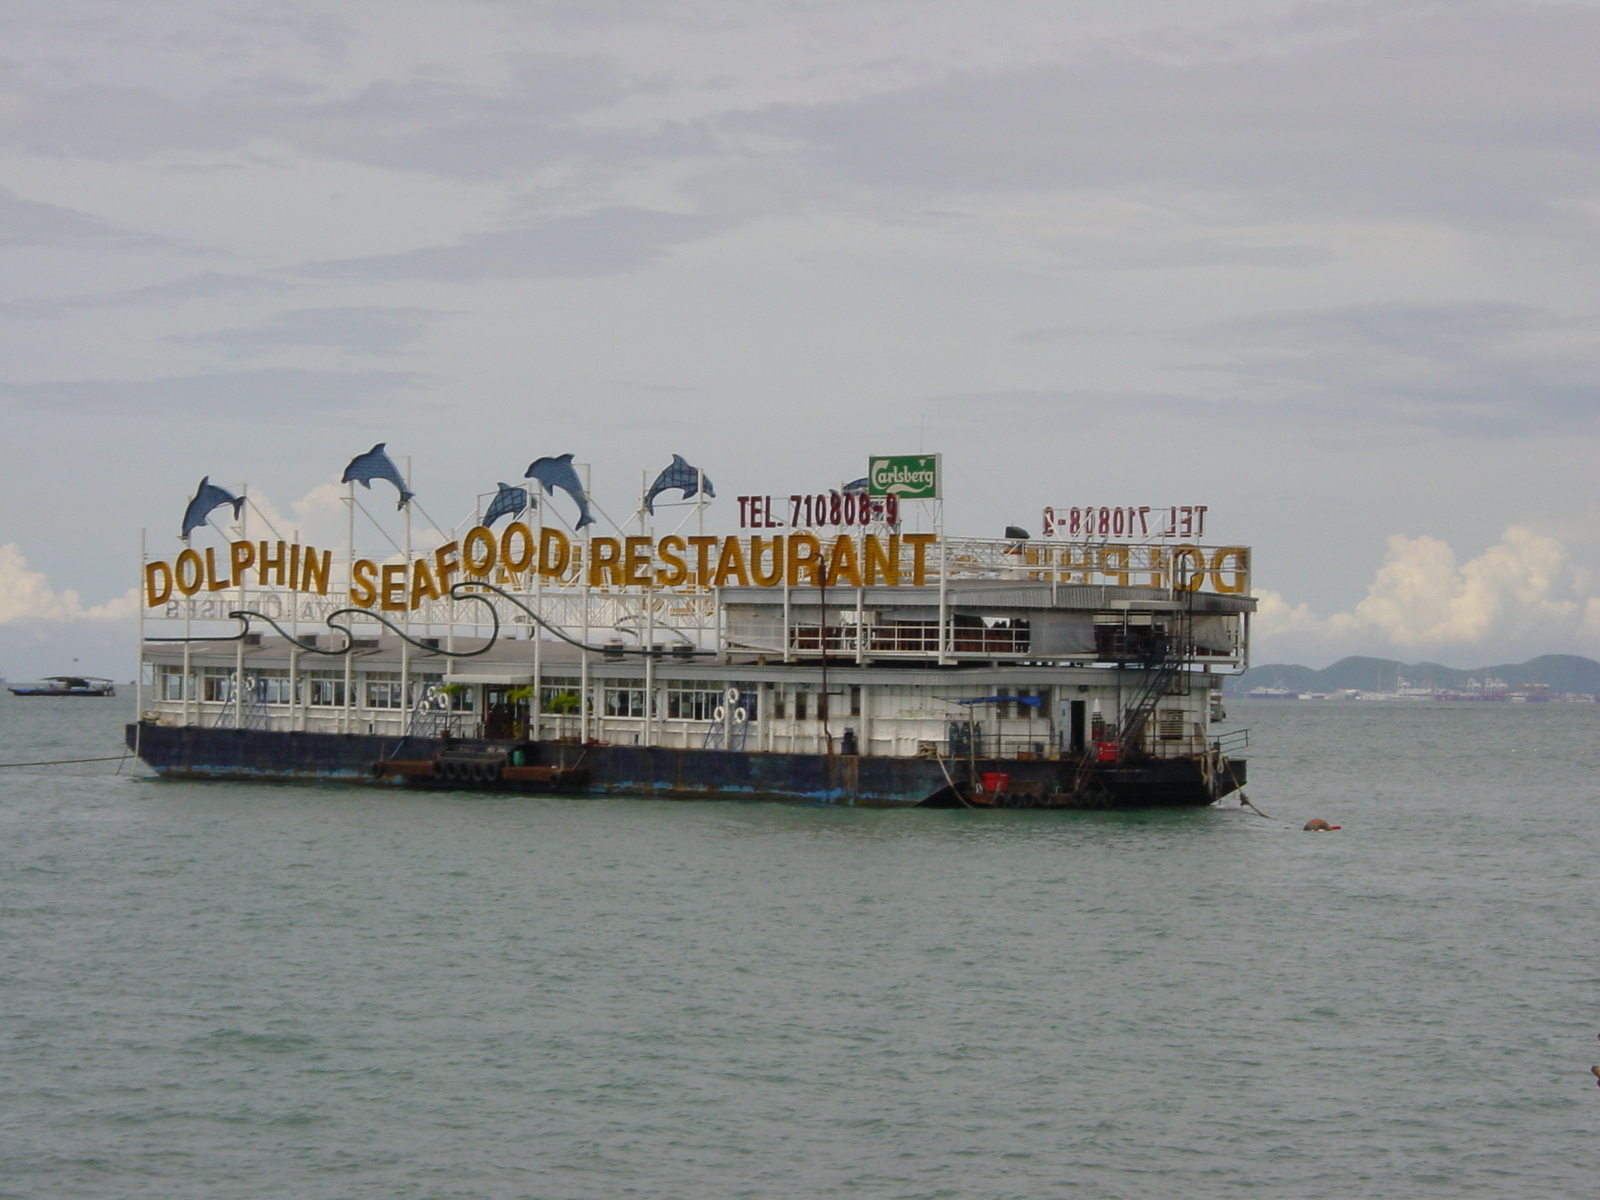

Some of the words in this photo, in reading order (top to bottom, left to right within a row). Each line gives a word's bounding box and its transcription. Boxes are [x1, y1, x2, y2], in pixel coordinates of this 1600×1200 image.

[871, 460, 934, 490] Carlsberg
[737, 496, 783, 528] TEL.
[790, 493, 898, 527] 710808-9
[146, 540, 332, 607] DOLPHIN
[351, 521, 570, 611] SEAFOOD
[590, 534, 937, 588] RESTAURANT
